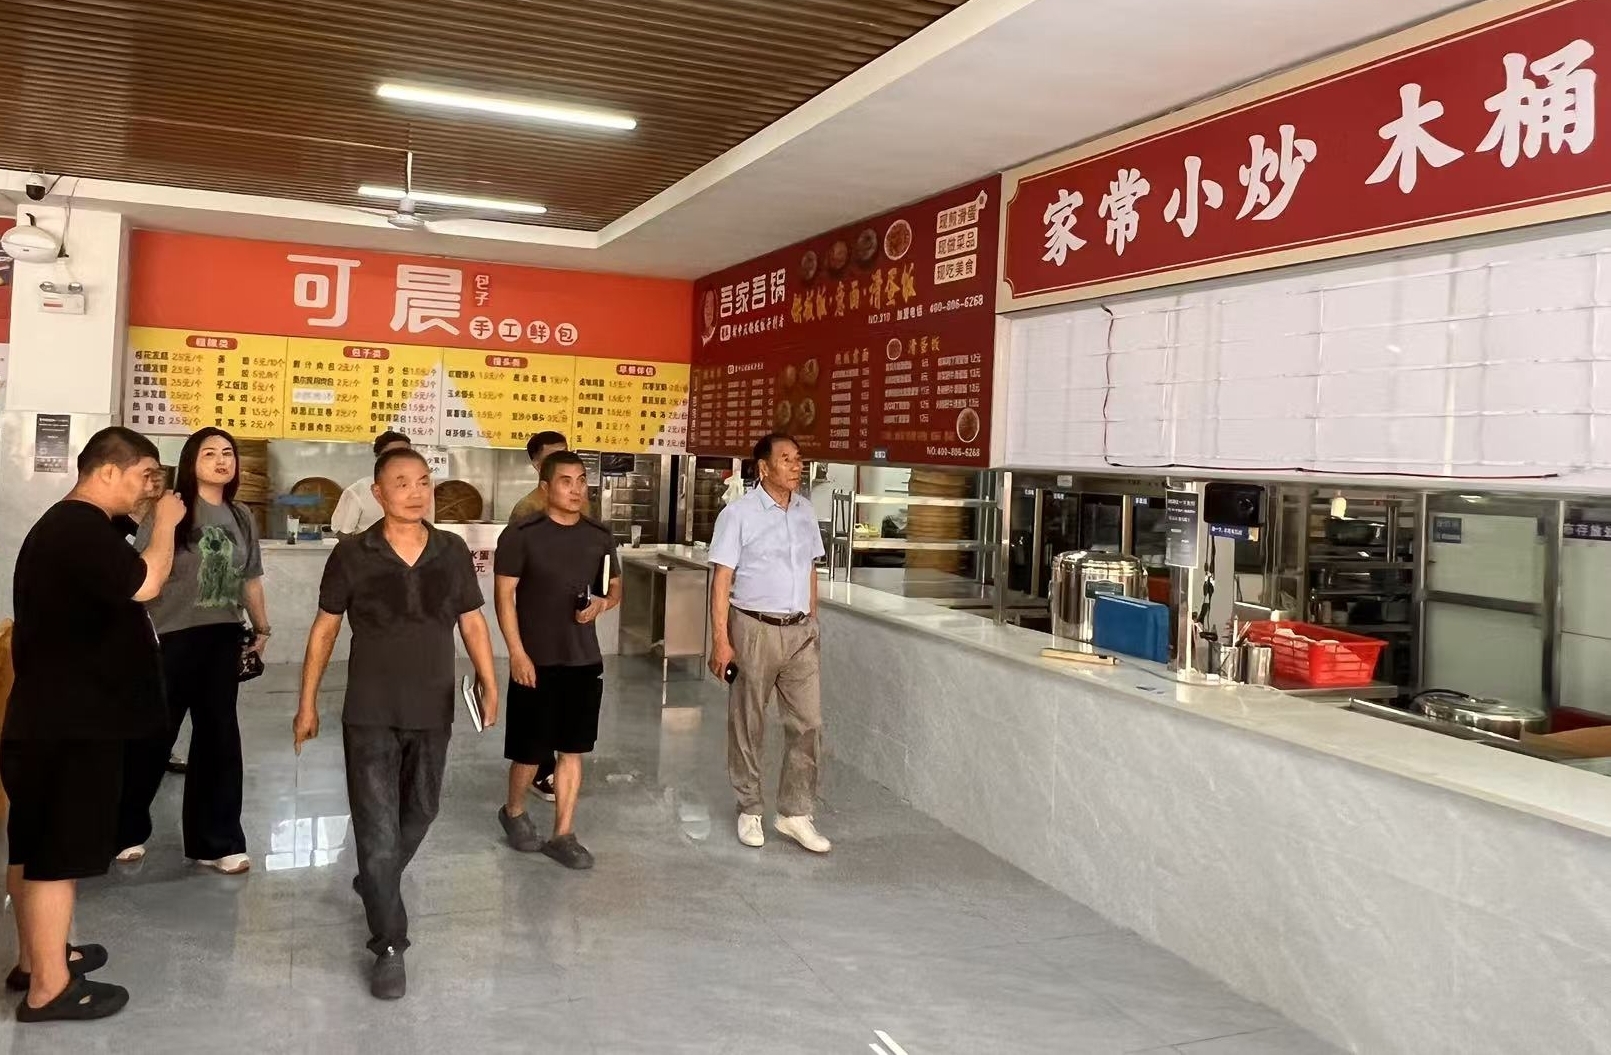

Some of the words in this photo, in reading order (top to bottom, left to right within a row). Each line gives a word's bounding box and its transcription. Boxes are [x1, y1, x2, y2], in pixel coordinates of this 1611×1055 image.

[1042, 125, 1316, 267] 家常小炒
[1365, 39, 1597, 193] 木桶
[936, 259, 974, 280] 现吃美食
[287, 254, 463, 336] 可晨
[475, 274, 490, 306] 包子
[473, 320, 573, 342] 手工鲜包
